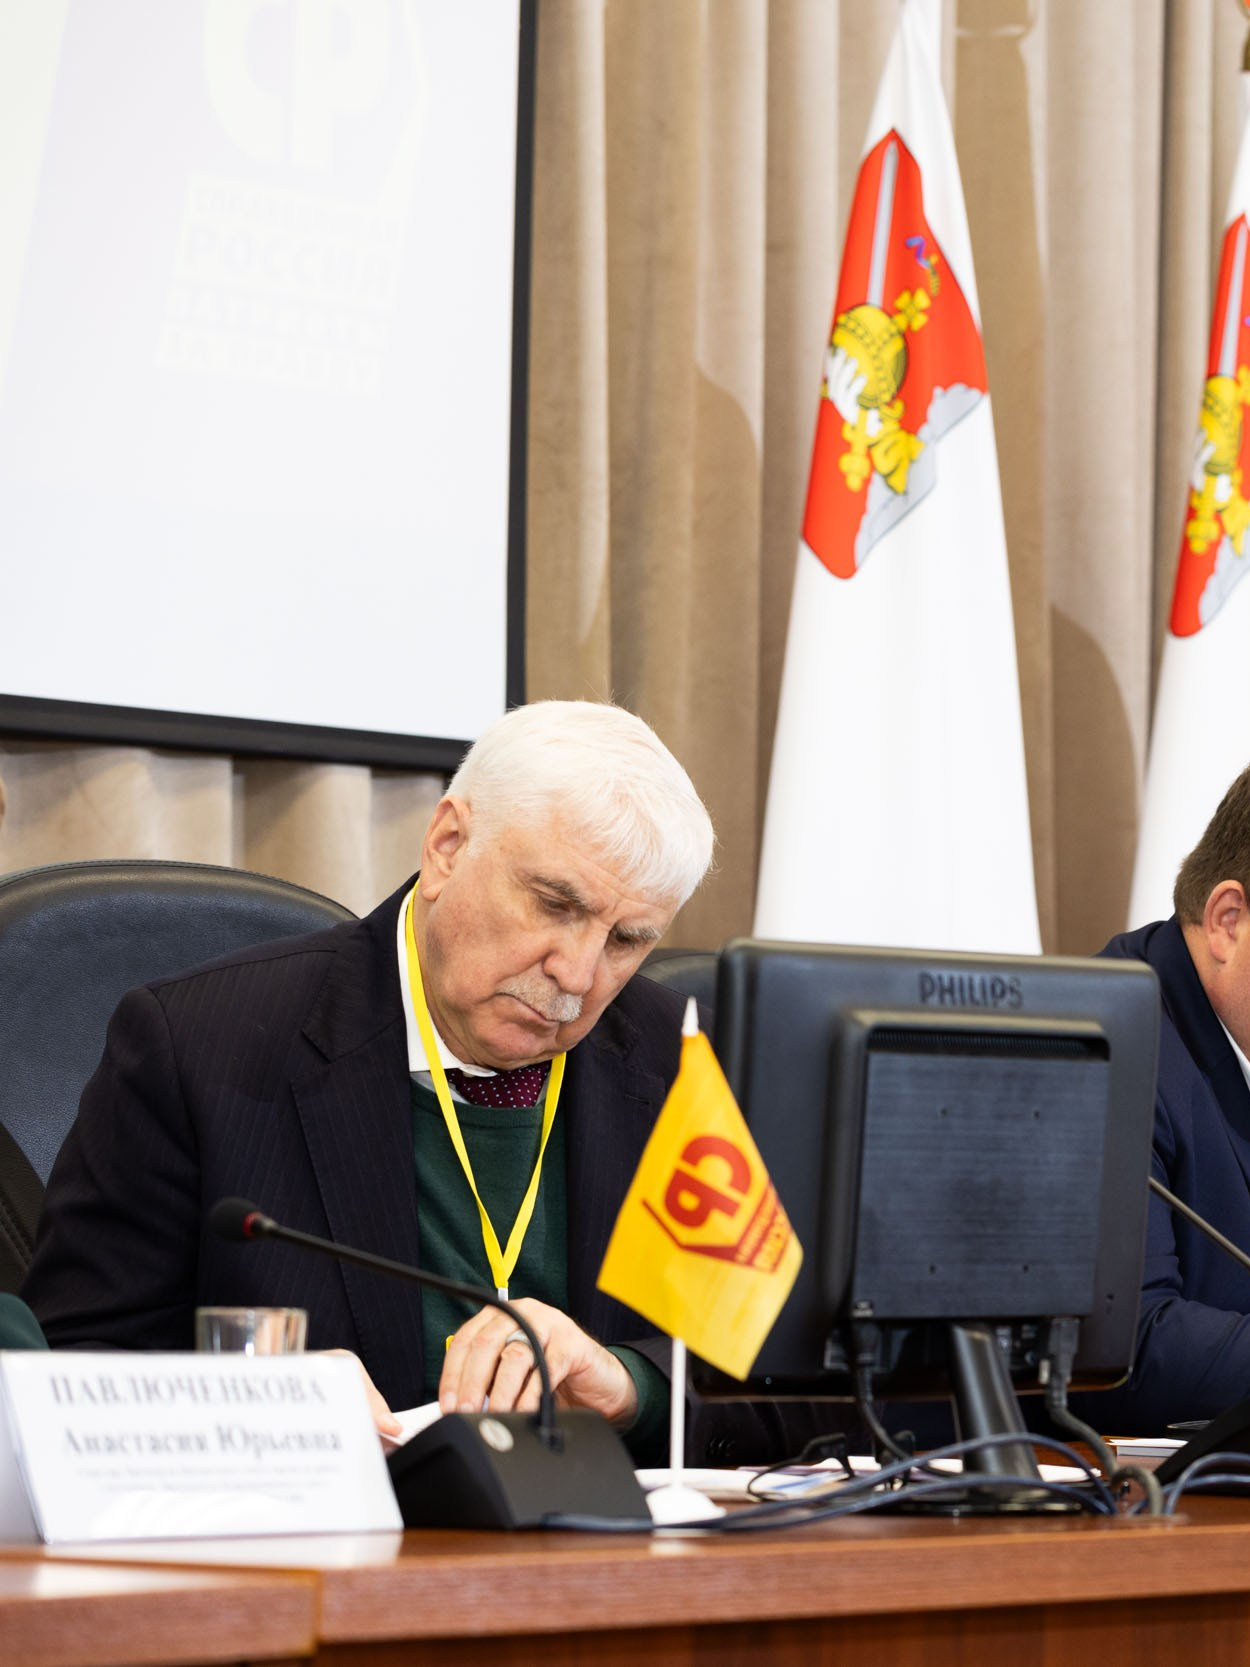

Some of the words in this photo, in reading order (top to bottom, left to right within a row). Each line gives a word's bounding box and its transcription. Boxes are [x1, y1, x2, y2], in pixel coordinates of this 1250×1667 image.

[919, 970, 1024, 1010] PHILIPS
[49, 1374, 329, 1405] ПАВЛЮЧЕНКОВА
[62, 1427, 208, 1456] Анастасия
[216, 1424, 343, 1459] Юрьевна
